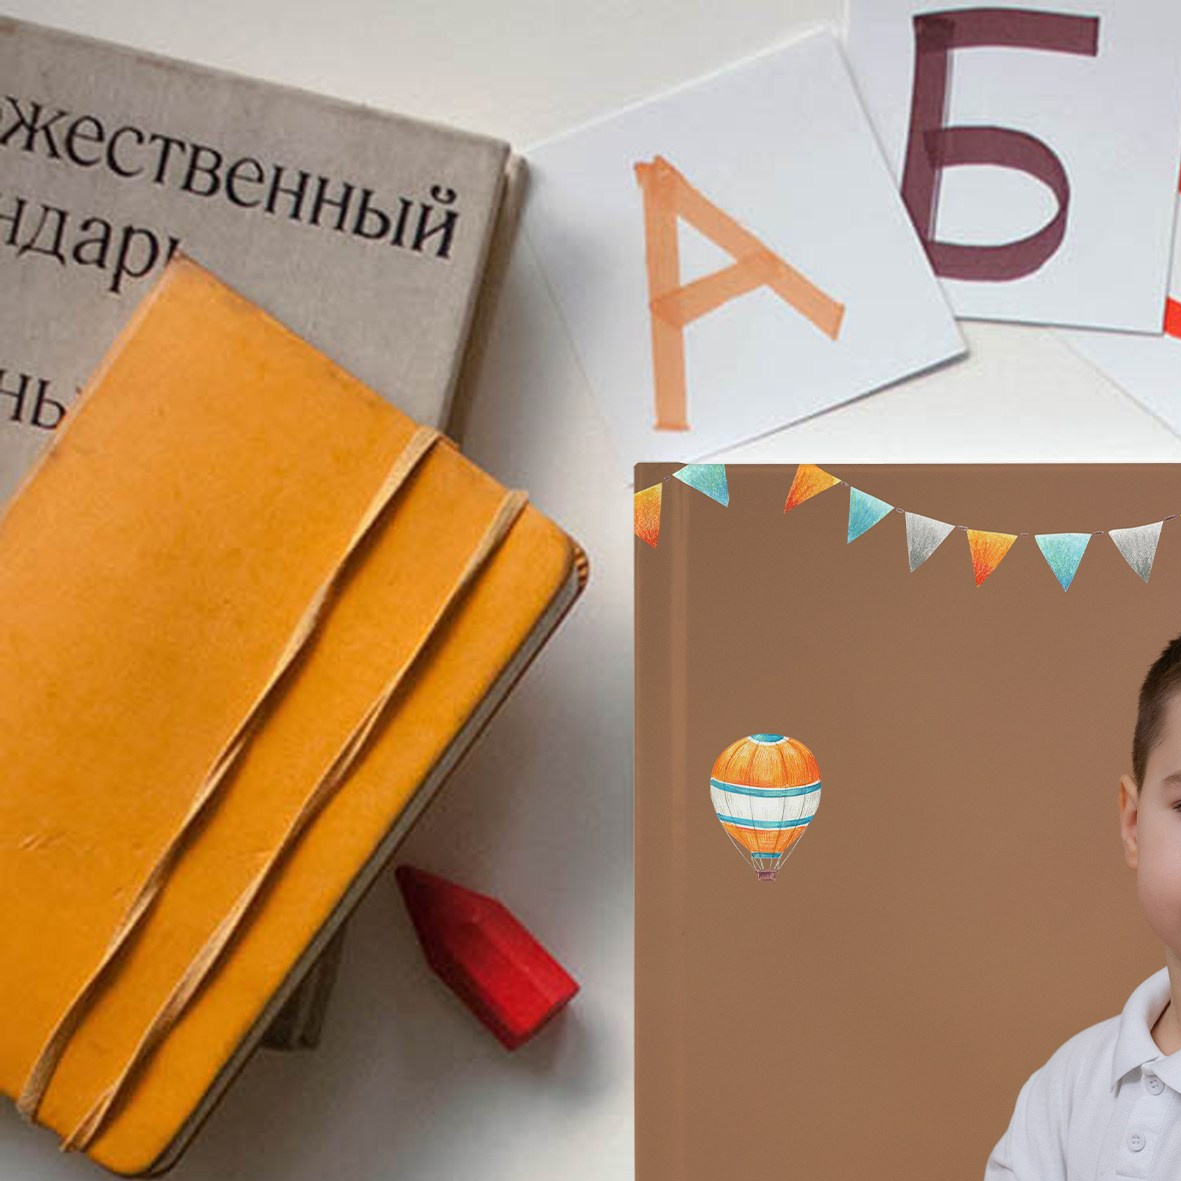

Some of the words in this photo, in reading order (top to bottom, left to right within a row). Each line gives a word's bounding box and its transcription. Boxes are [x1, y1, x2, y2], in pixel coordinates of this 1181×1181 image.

[0, 96, 459, 260] жественный
[902, 7, 1100, 283] Б
[634, 155, 844, 431] А
